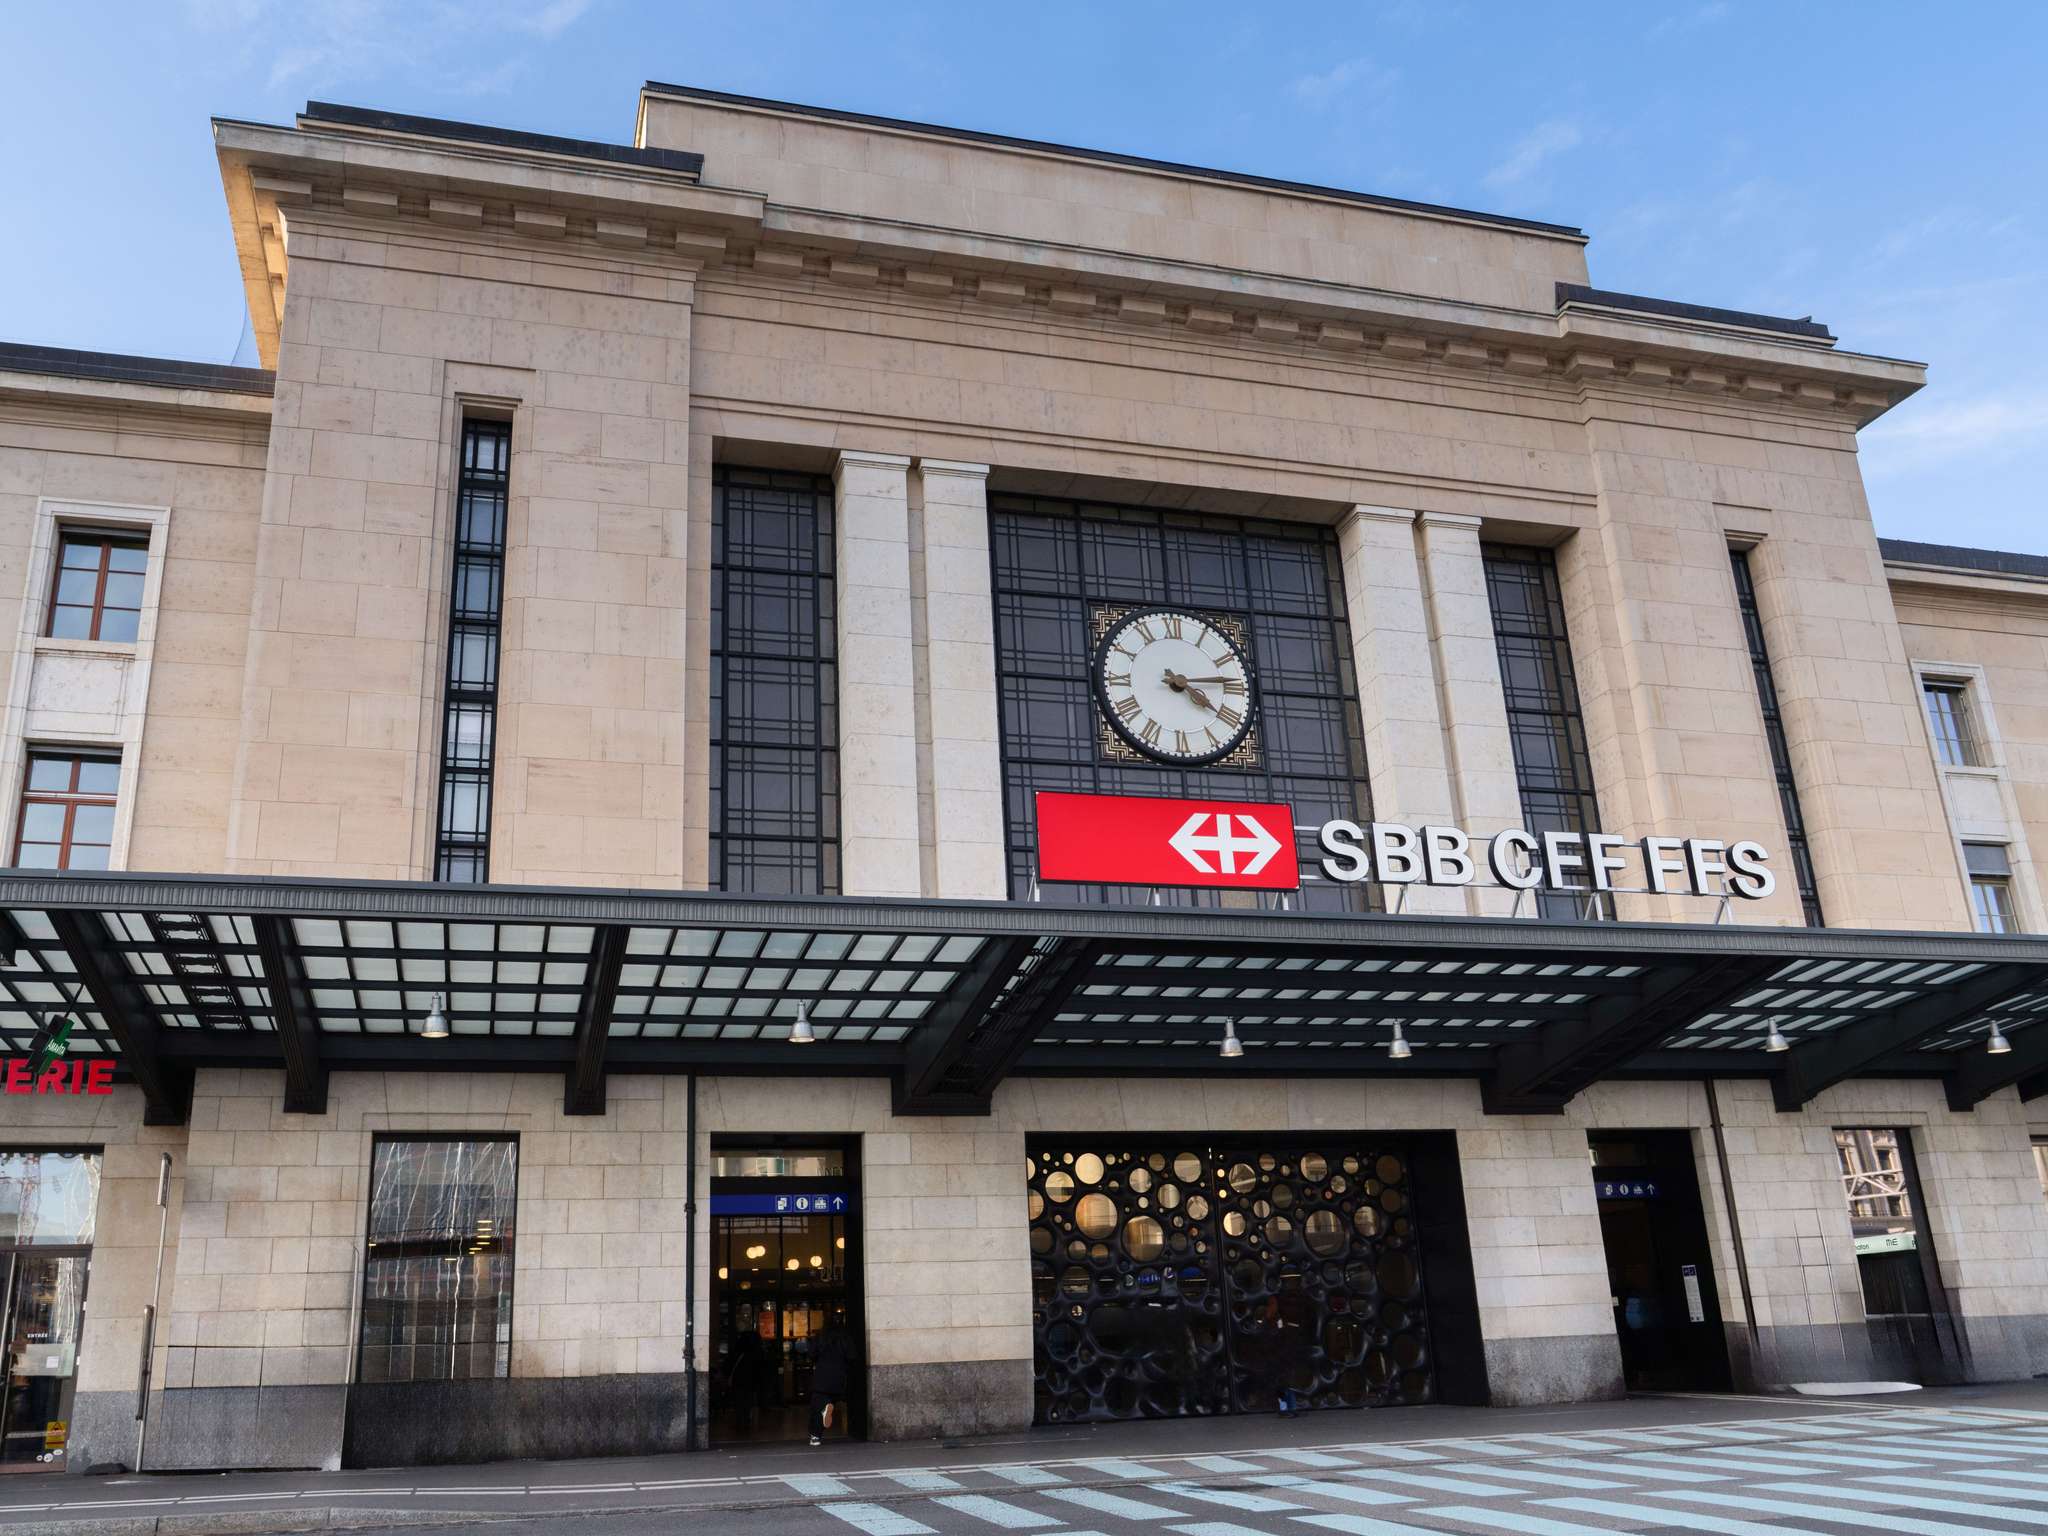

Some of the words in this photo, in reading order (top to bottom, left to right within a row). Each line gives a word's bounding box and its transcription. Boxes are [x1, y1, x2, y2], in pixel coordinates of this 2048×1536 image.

[1134, 621, 1157, 646] XI
[1162, 617, 1183, 640] XII
[1213, 651, 1235, 668] II
[1318, 819, 1475, 886] SBB
[1489, 828, 1627, 891] CFF
[1640, 836, 1777, 900] FFS
[0, 1058, 117, 1095] ERIE
